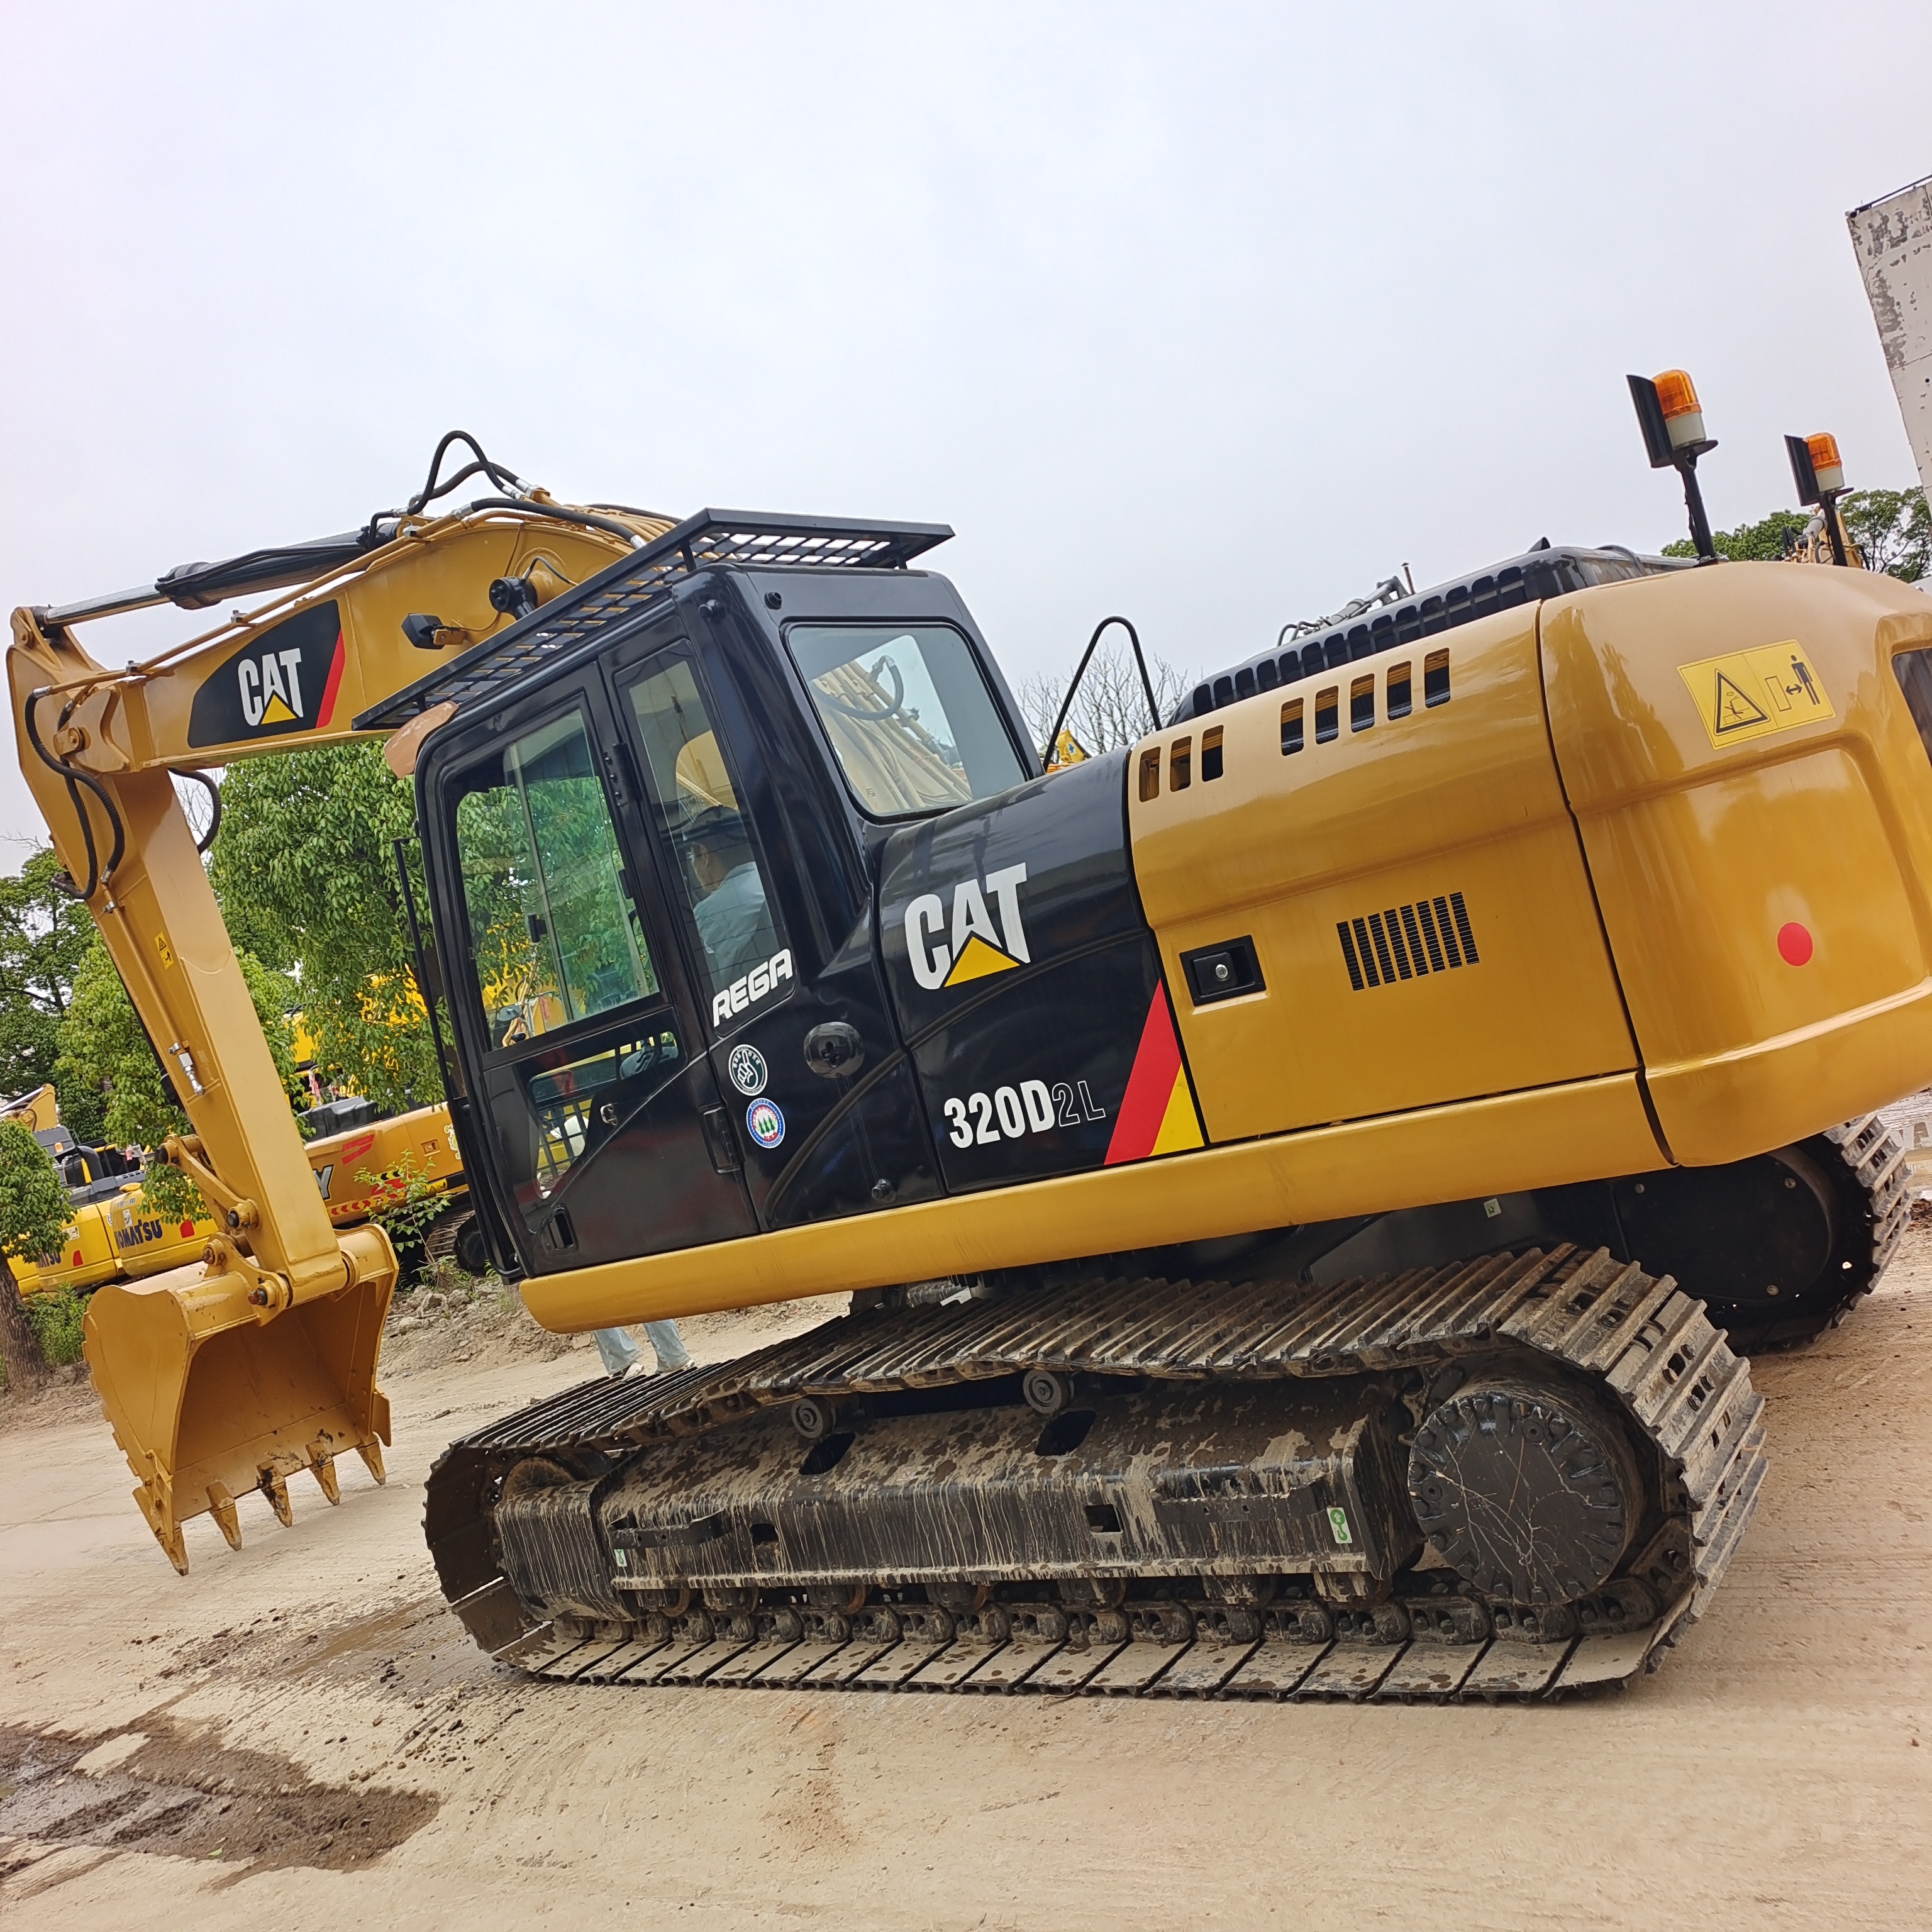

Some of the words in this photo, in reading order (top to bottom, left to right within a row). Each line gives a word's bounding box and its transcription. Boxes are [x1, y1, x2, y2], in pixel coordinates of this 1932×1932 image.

[238, 647, 304, 726] CAT
[904, 862, 1031, 990] CAT
[712, 948, 793, 1028] REGA
[113, 1219, 163, 1250] KOMATSU
